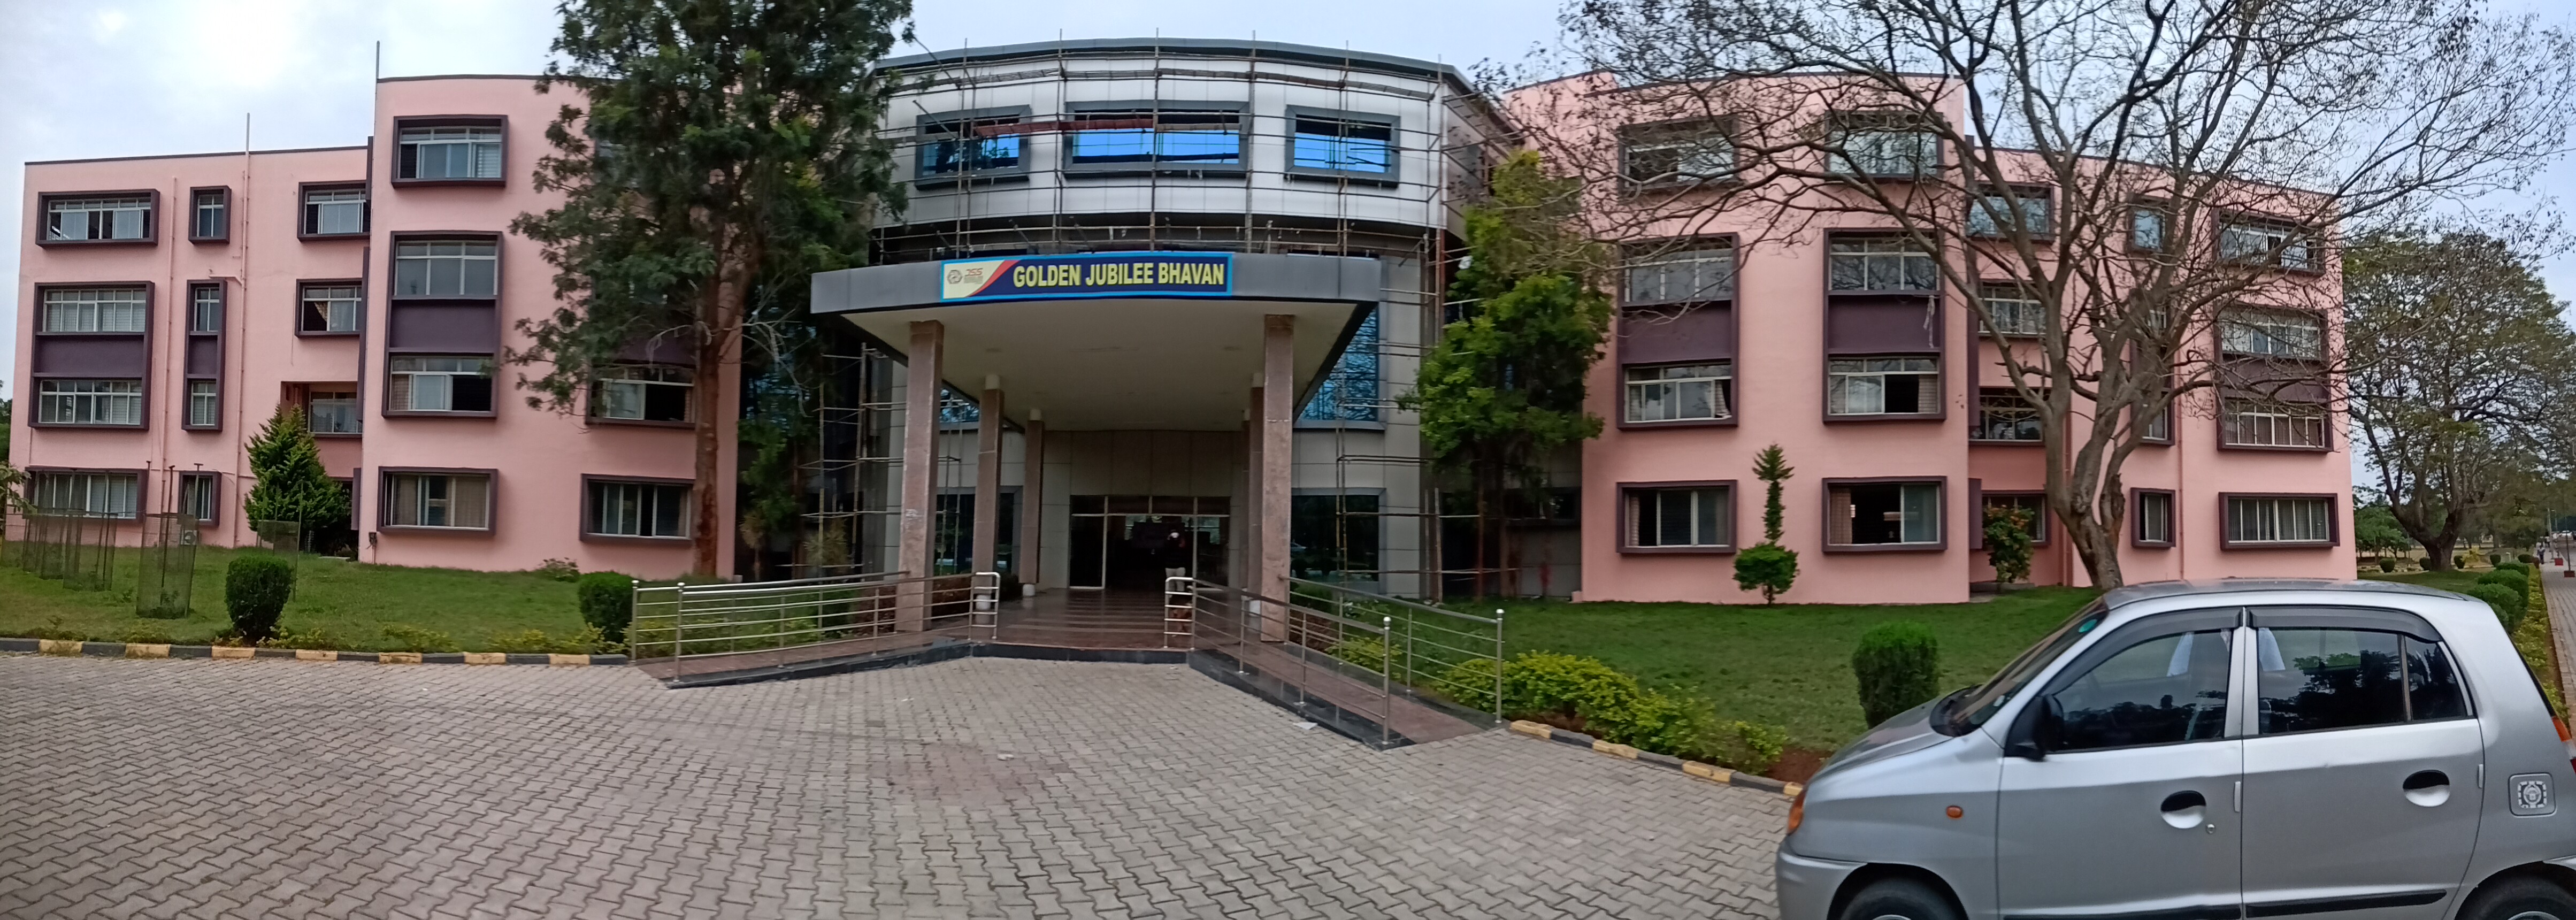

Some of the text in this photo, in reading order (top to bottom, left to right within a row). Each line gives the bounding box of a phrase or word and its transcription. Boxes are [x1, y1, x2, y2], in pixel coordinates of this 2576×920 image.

[1014, 263, 1224, 288] GOLDEN JUBILEE BHAVAN
